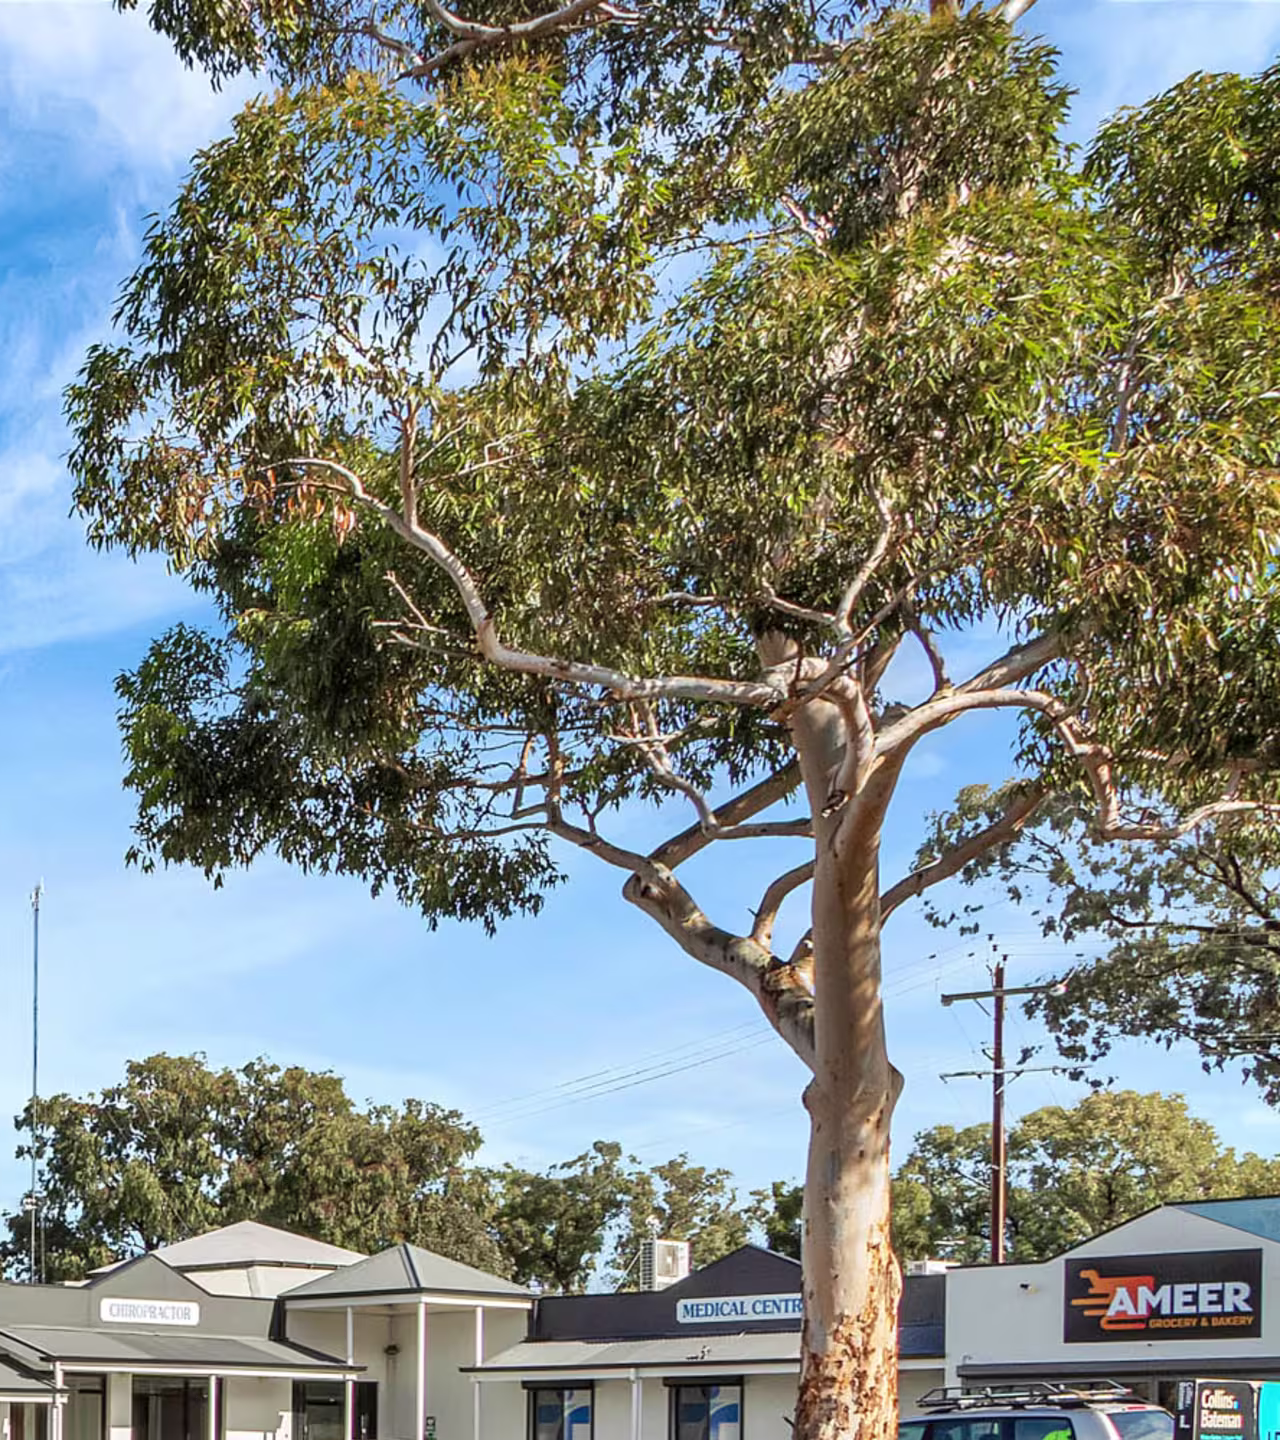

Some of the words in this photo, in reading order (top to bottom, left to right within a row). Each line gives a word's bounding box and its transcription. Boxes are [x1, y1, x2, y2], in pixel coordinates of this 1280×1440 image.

[683, 1301, 747, 1318] MEDICAL
[752, 1298, 803, 1315] CENTR
[1106, 1281, 1253, 1316] AMEER
[1149, 1318, 1197, 1328] GROCERY
[1201, 1318, 1208, 1327] &
[1212, 1316, 1254, 1327] BAKERY
